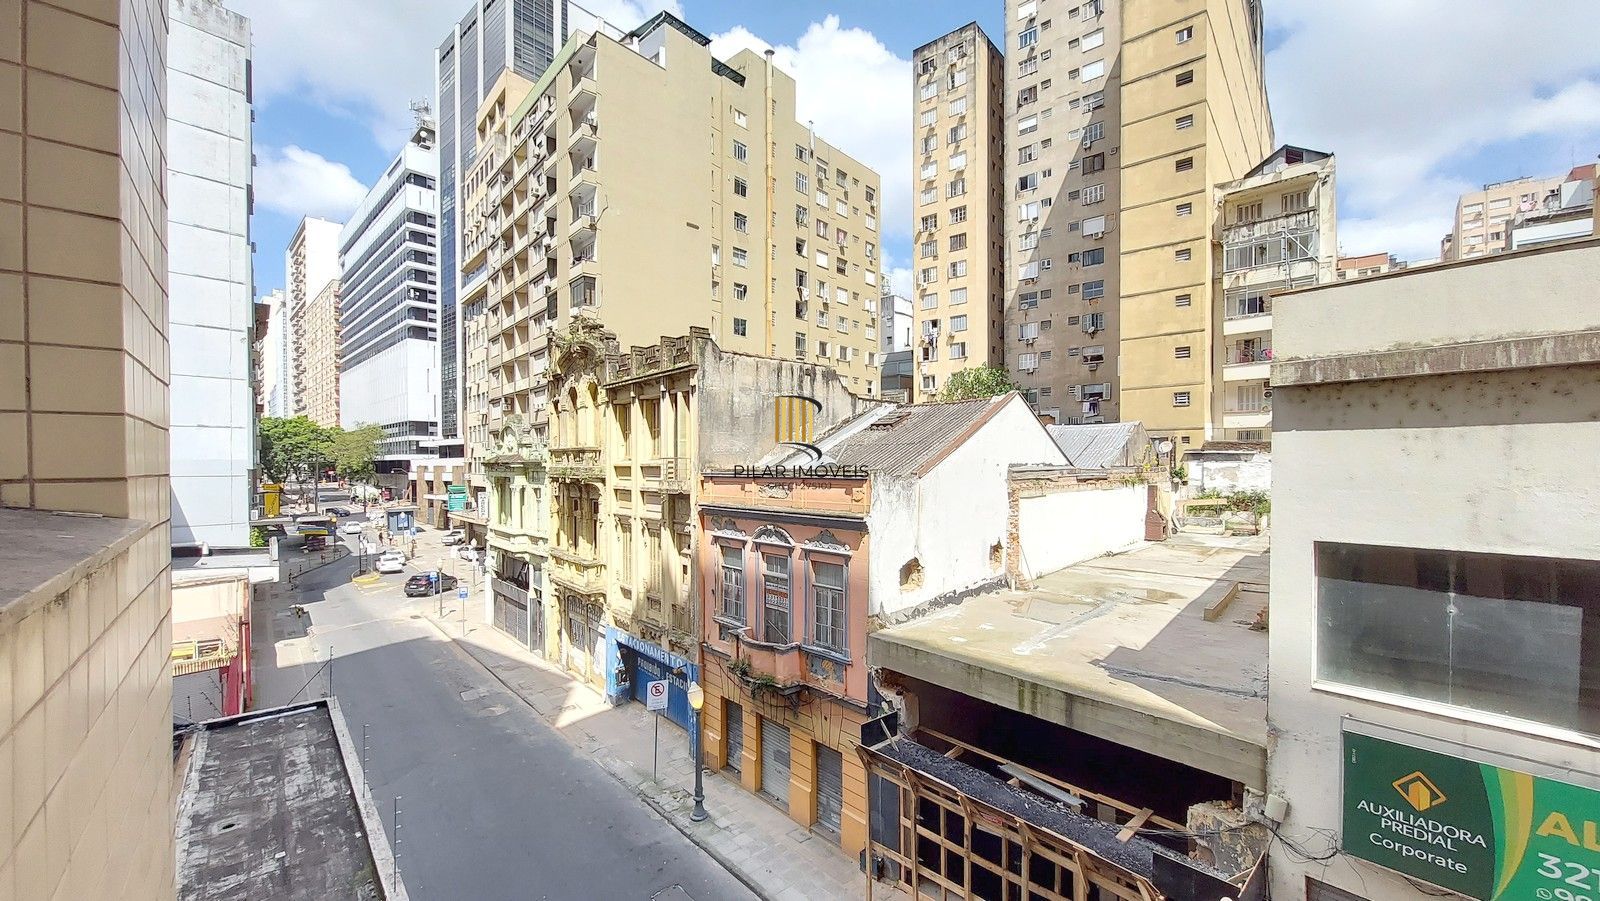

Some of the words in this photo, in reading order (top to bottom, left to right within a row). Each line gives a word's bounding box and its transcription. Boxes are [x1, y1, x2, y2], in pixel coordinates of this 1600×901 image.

[617, 631, 683, 668] ESTACIONAMENTO
[1357, 800, 1487, 848] AUXILIADORA
[1381, 818, 1458, 852] PREDIAL
[1369, 833, 1468, 874] Corporate
